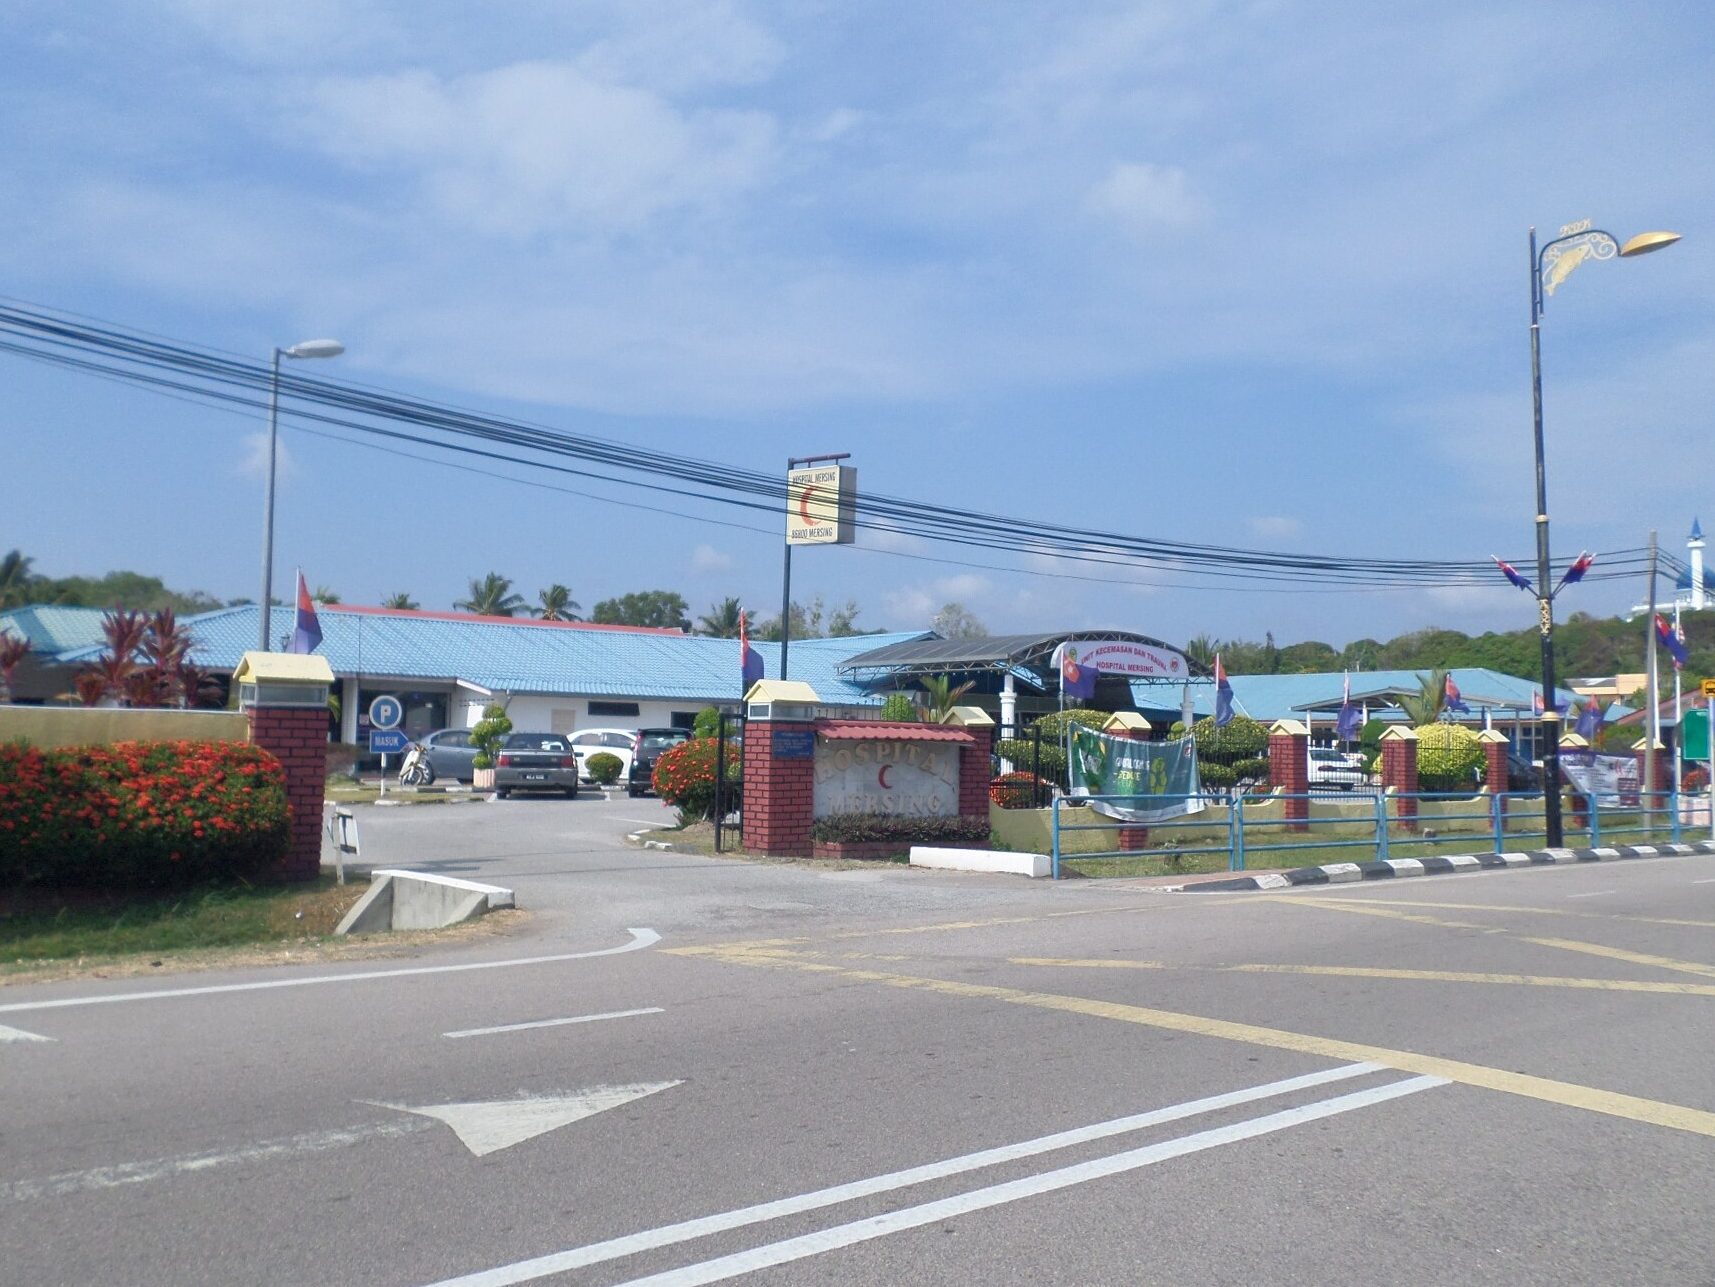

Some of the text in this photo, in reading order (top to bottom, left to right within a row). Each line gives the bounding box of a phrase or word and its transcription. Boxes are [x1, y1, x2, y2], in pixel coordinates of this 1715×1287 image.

[793, 472, 835, 483] HOSPITAL MERSING
[809, 527, 832, 537] MERSING
[1096, 645, 1133, 655] KECEMASAN
[1133, 648, 1146, 658] DAN
[1096, 661, 1154, 673] HOSPITAL MERSING
[380, 705, 391, 724] P
[814, 741, 952, 785] HOSPITAL
[827, 793, 942, 817] MERSING
